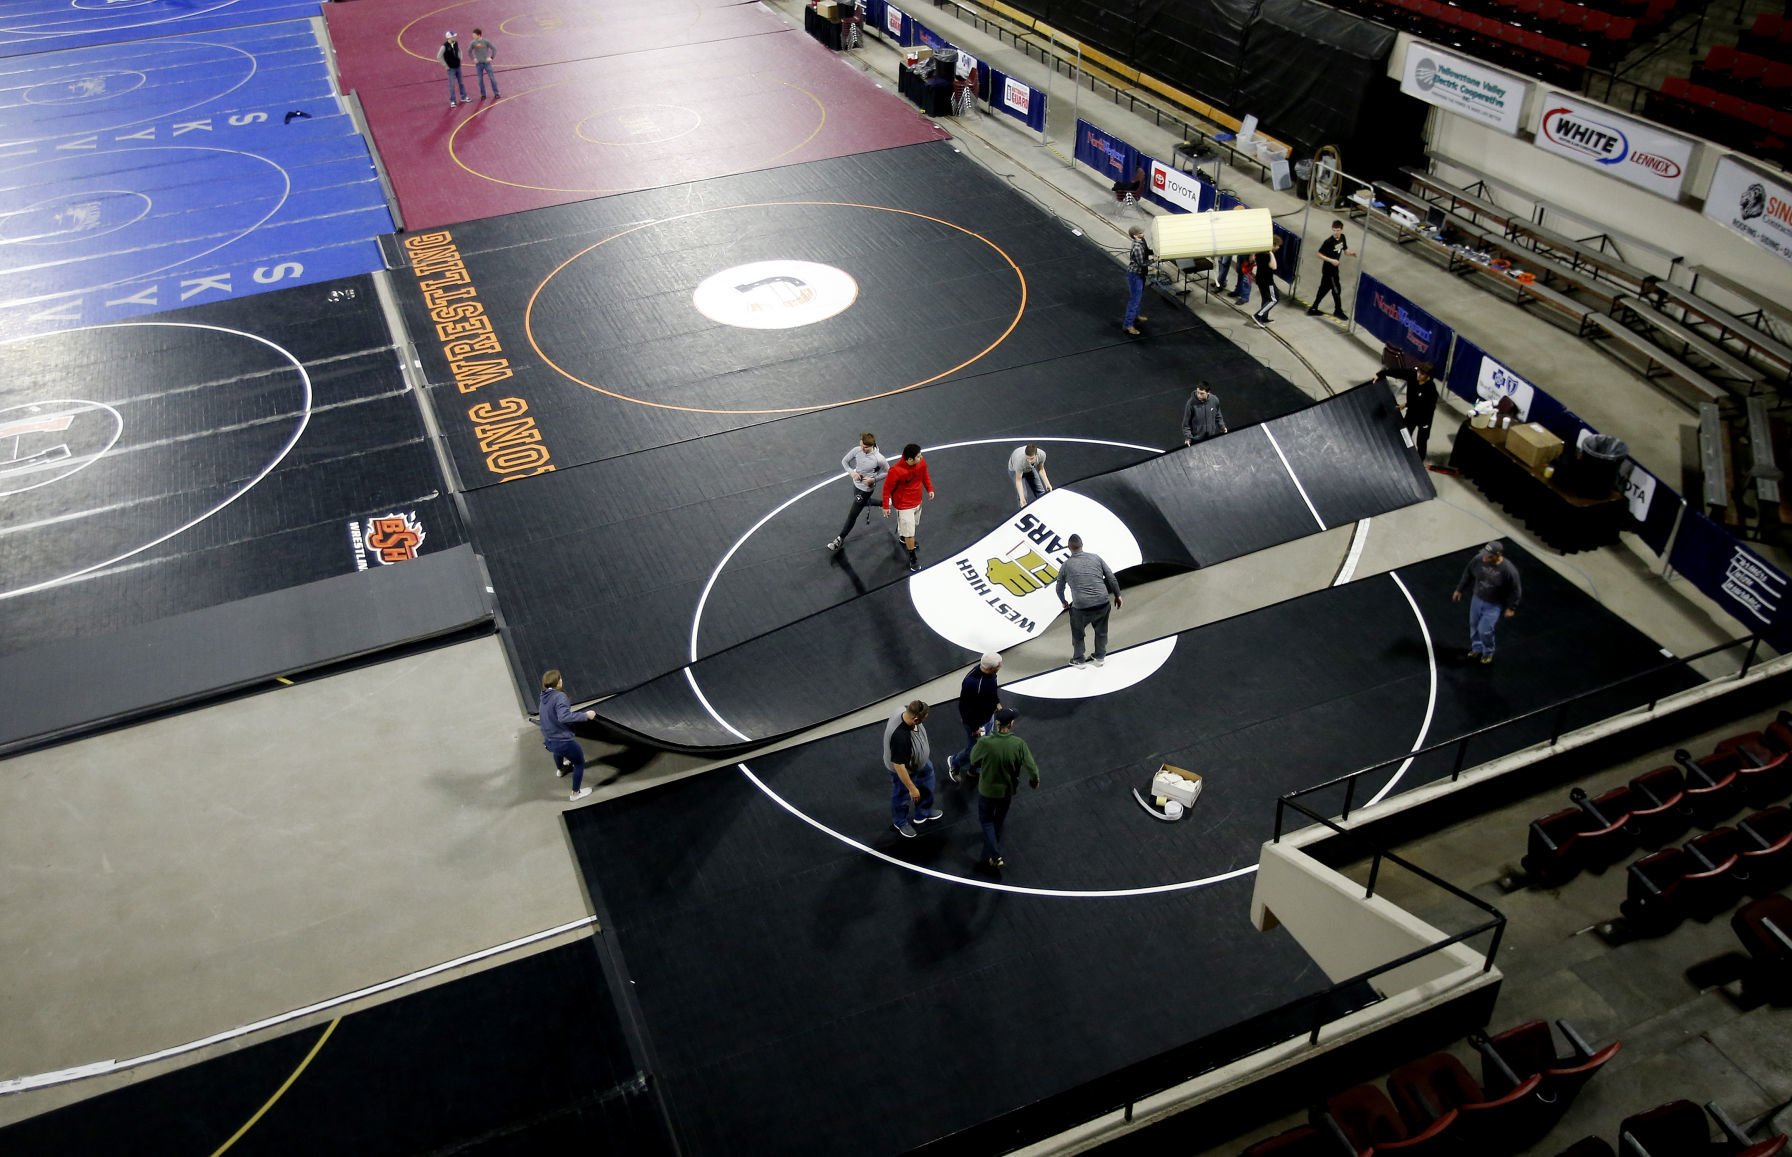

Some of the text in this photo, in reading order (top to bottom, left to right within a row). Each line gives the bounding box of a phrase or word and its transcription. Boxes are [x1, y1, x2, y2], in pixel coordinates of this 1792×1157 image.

[1438, 64, 1507, 99] Yellowstone Valley
[1460, 85, 1505, 109] Cooperative
[1555, 117, 1618, 154] WHITE
[1629, 151, 1672, 175] LENNOX
[1167, 180, 1197, 203] TOYOTA
[404, 231, 557, 482] ONC WRESTLING
[955, 558, 1036, 633] WEST HIGH
